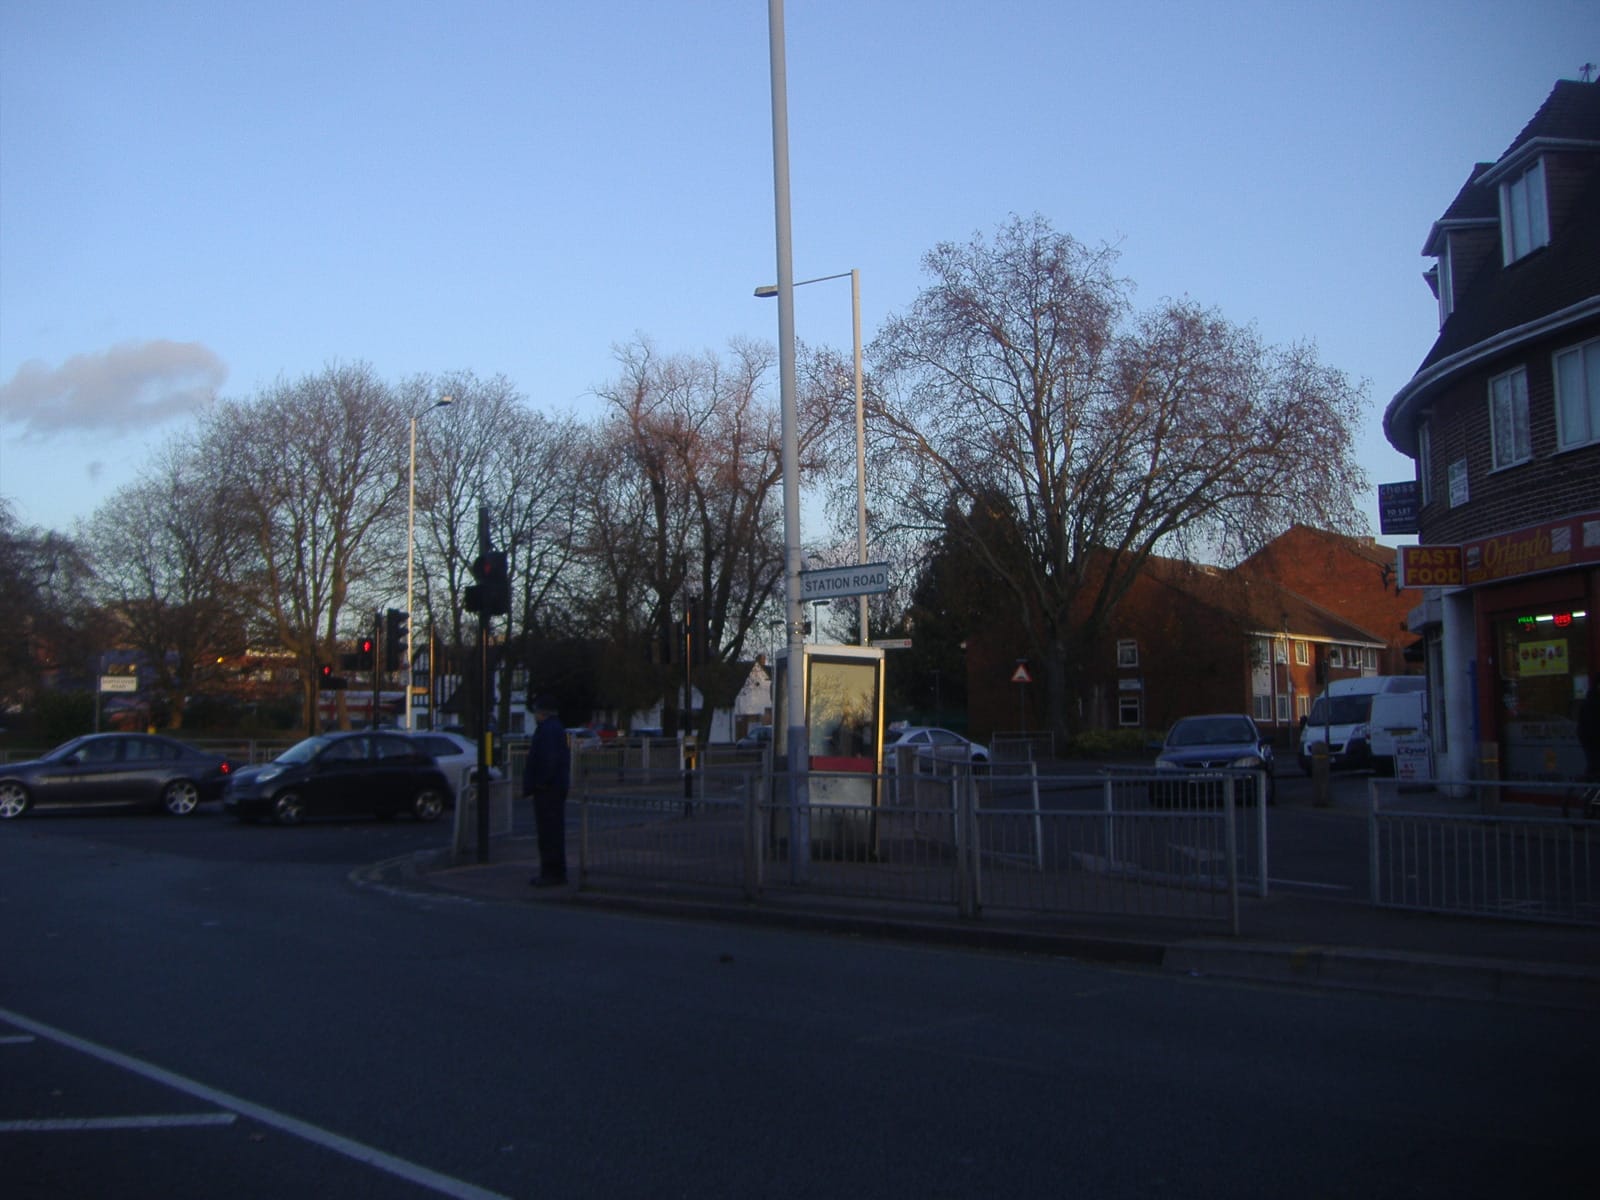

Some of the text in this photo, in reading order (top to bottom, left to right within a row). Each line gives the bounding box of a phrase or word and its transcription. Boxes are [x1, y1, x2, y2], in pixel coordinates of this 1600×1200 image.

[1483, 527, 1549, 567] Orlando
[1408, 549, 1458, 565] FAST
[805, 573, 885, 592] STATION ROAD
[1407, 567, 1462, 584] FOOD
